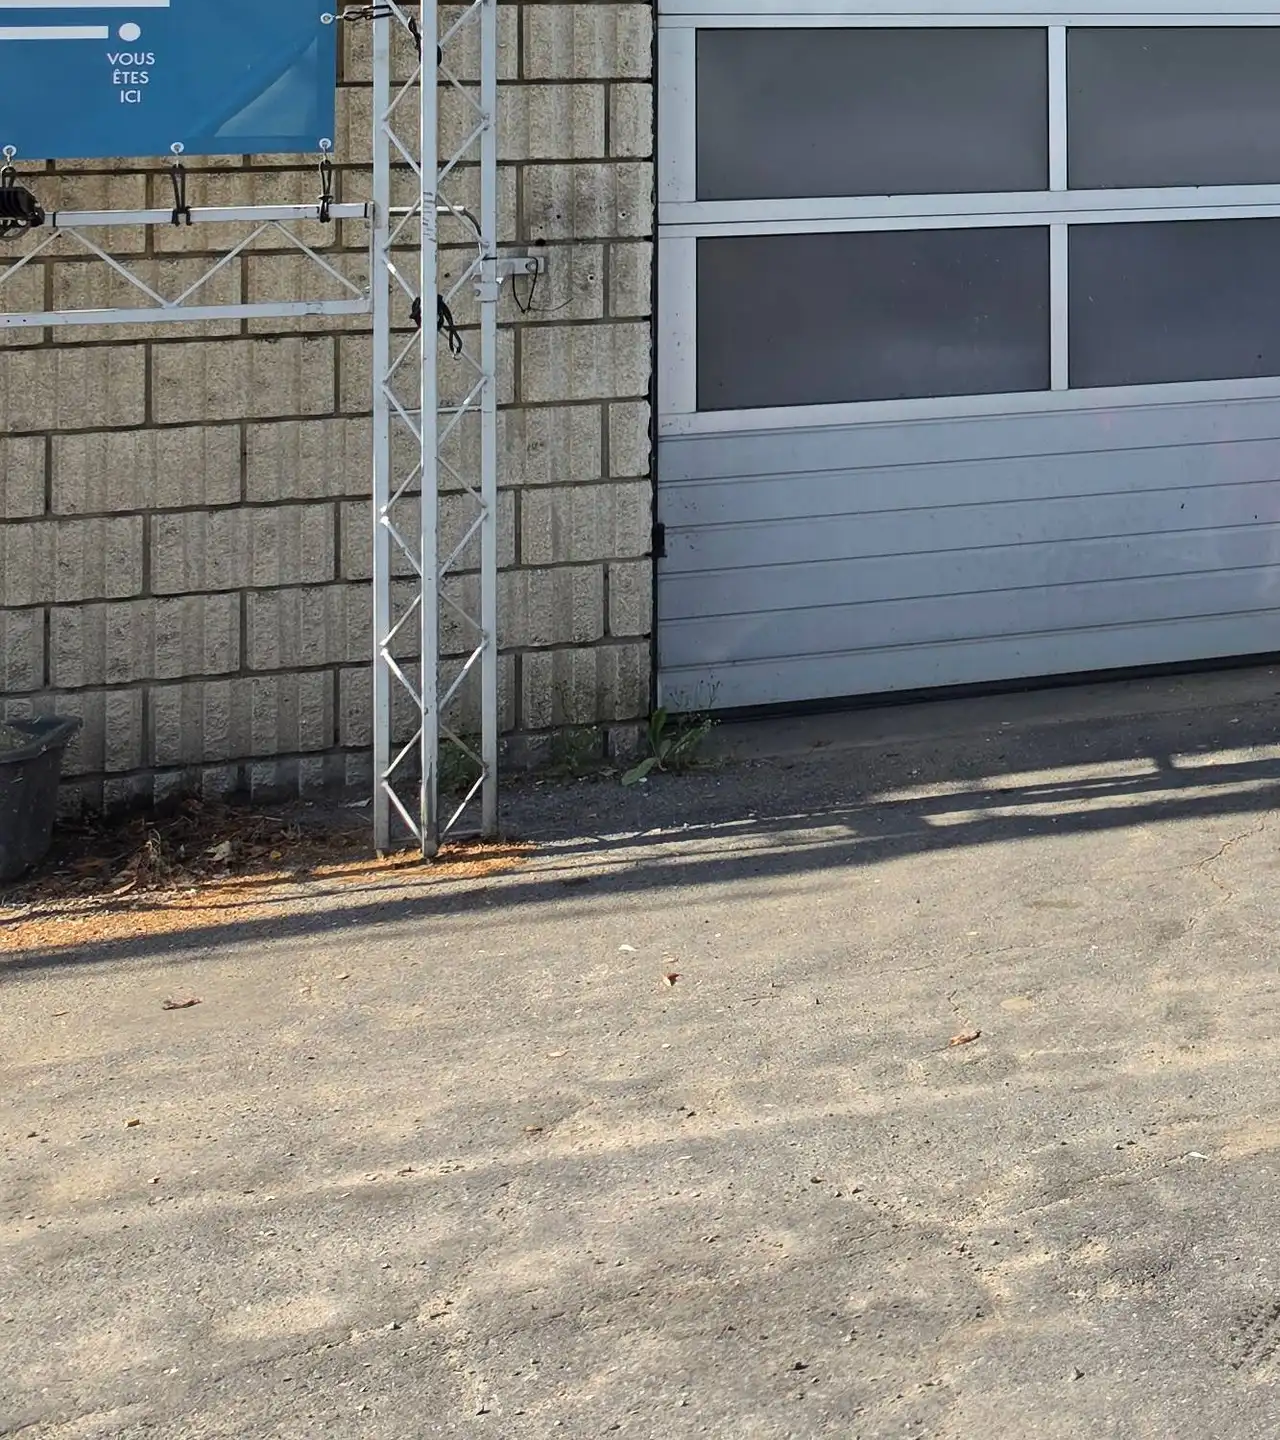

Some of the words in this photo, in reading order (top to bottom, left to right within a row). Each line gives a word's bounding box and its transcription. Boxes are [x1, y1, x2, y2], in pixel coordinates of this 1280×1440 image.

[107, 52, 155, 66] VOUS
[113, 68, 149, 84] ÊTES
[120, 90, 141, 103] ICI
